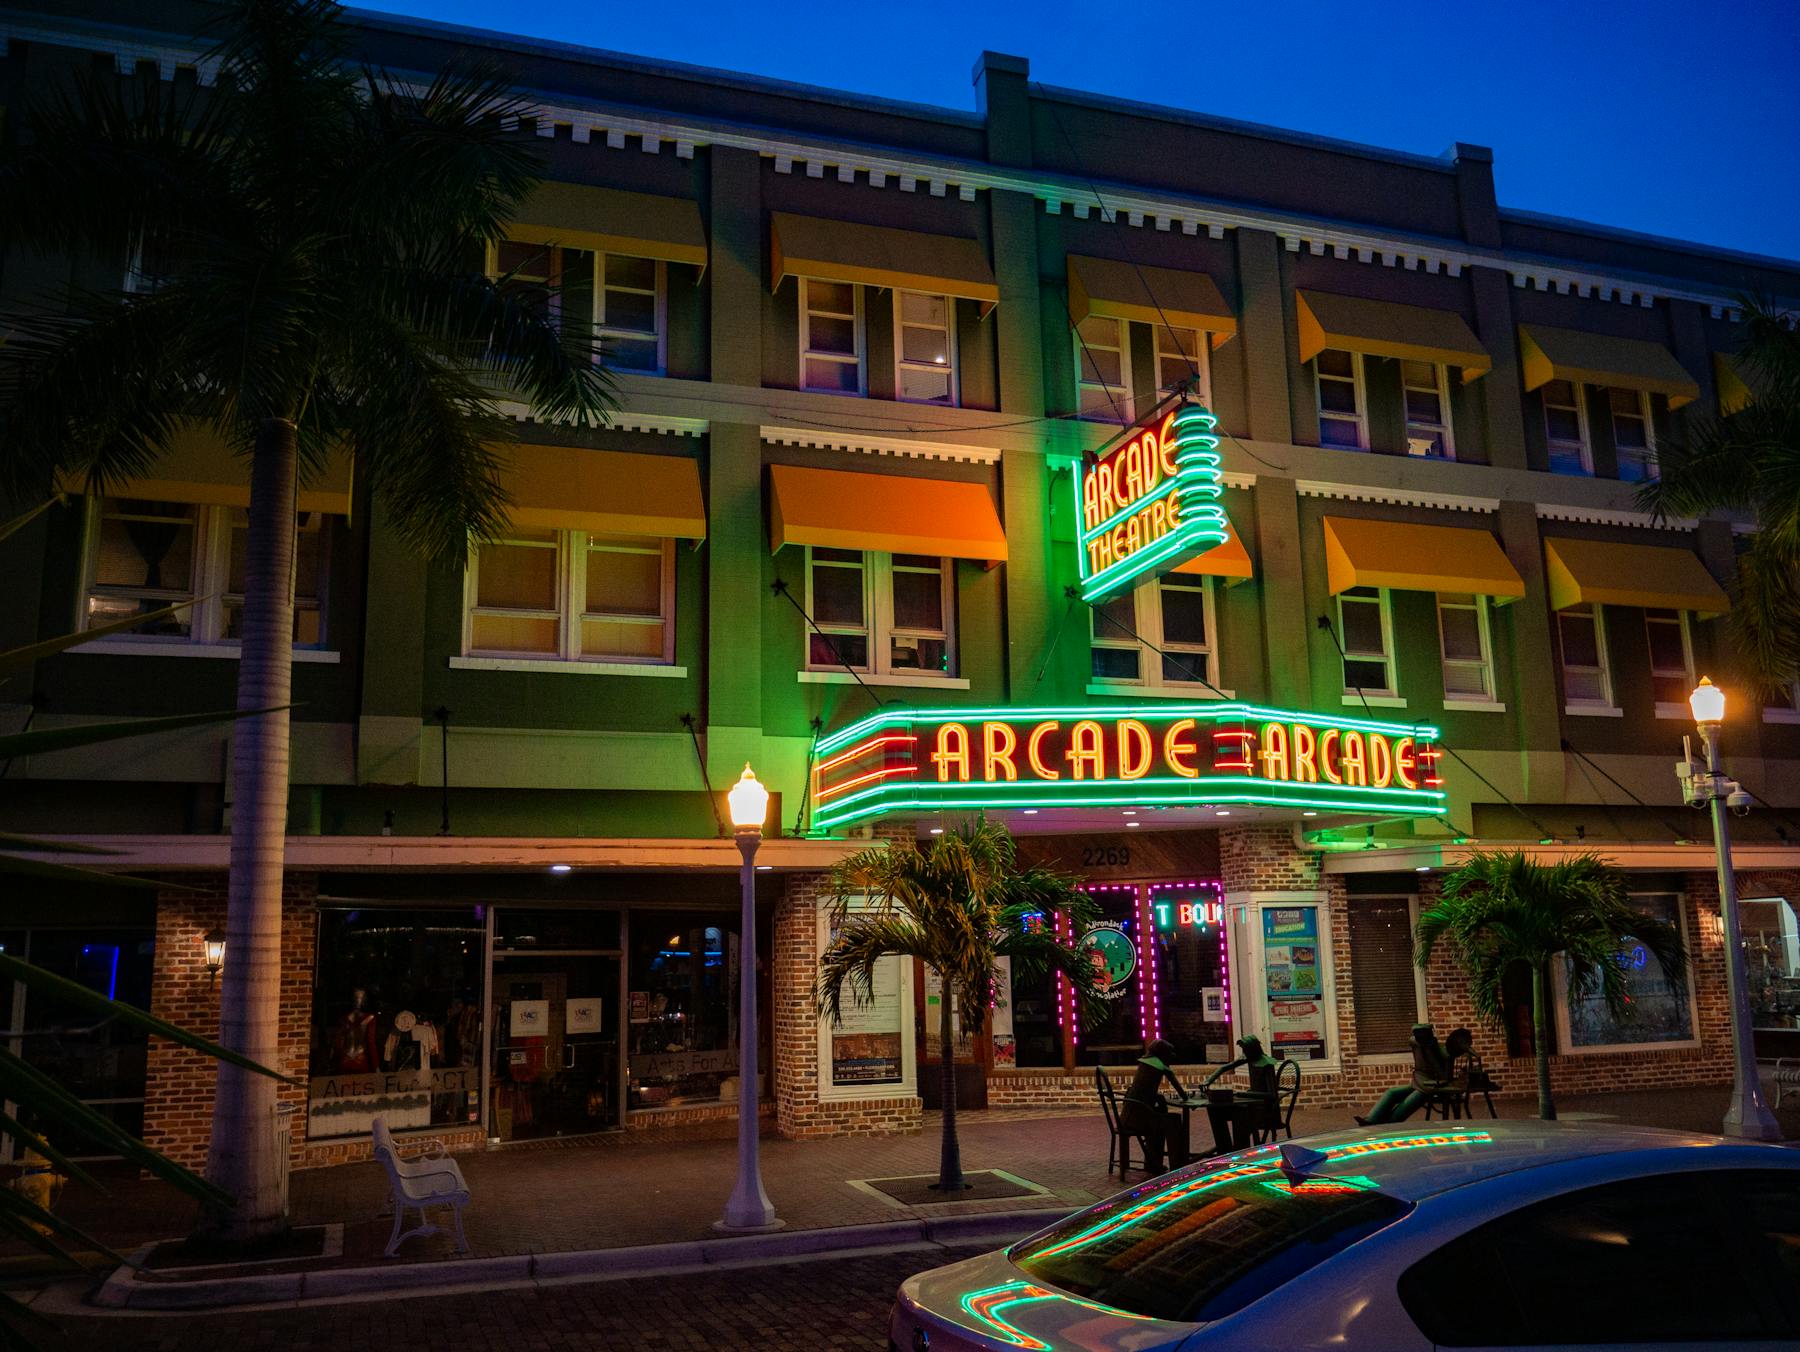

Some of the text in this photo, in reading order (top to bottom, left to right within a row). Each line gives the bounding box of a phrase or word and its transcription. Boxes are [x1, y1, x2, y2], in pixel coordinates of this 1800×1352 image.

[1084, 412, 1178, 531] ARCADE
[1087, 488, 1182, 576] THEATRE
[930, 719, 1199, 782] ARCADE
[1258, 722, 1416, 790] ARCADE
[1083, 848, 1130, 867] 2269
[323, 1079, 376, 1098] Arts
